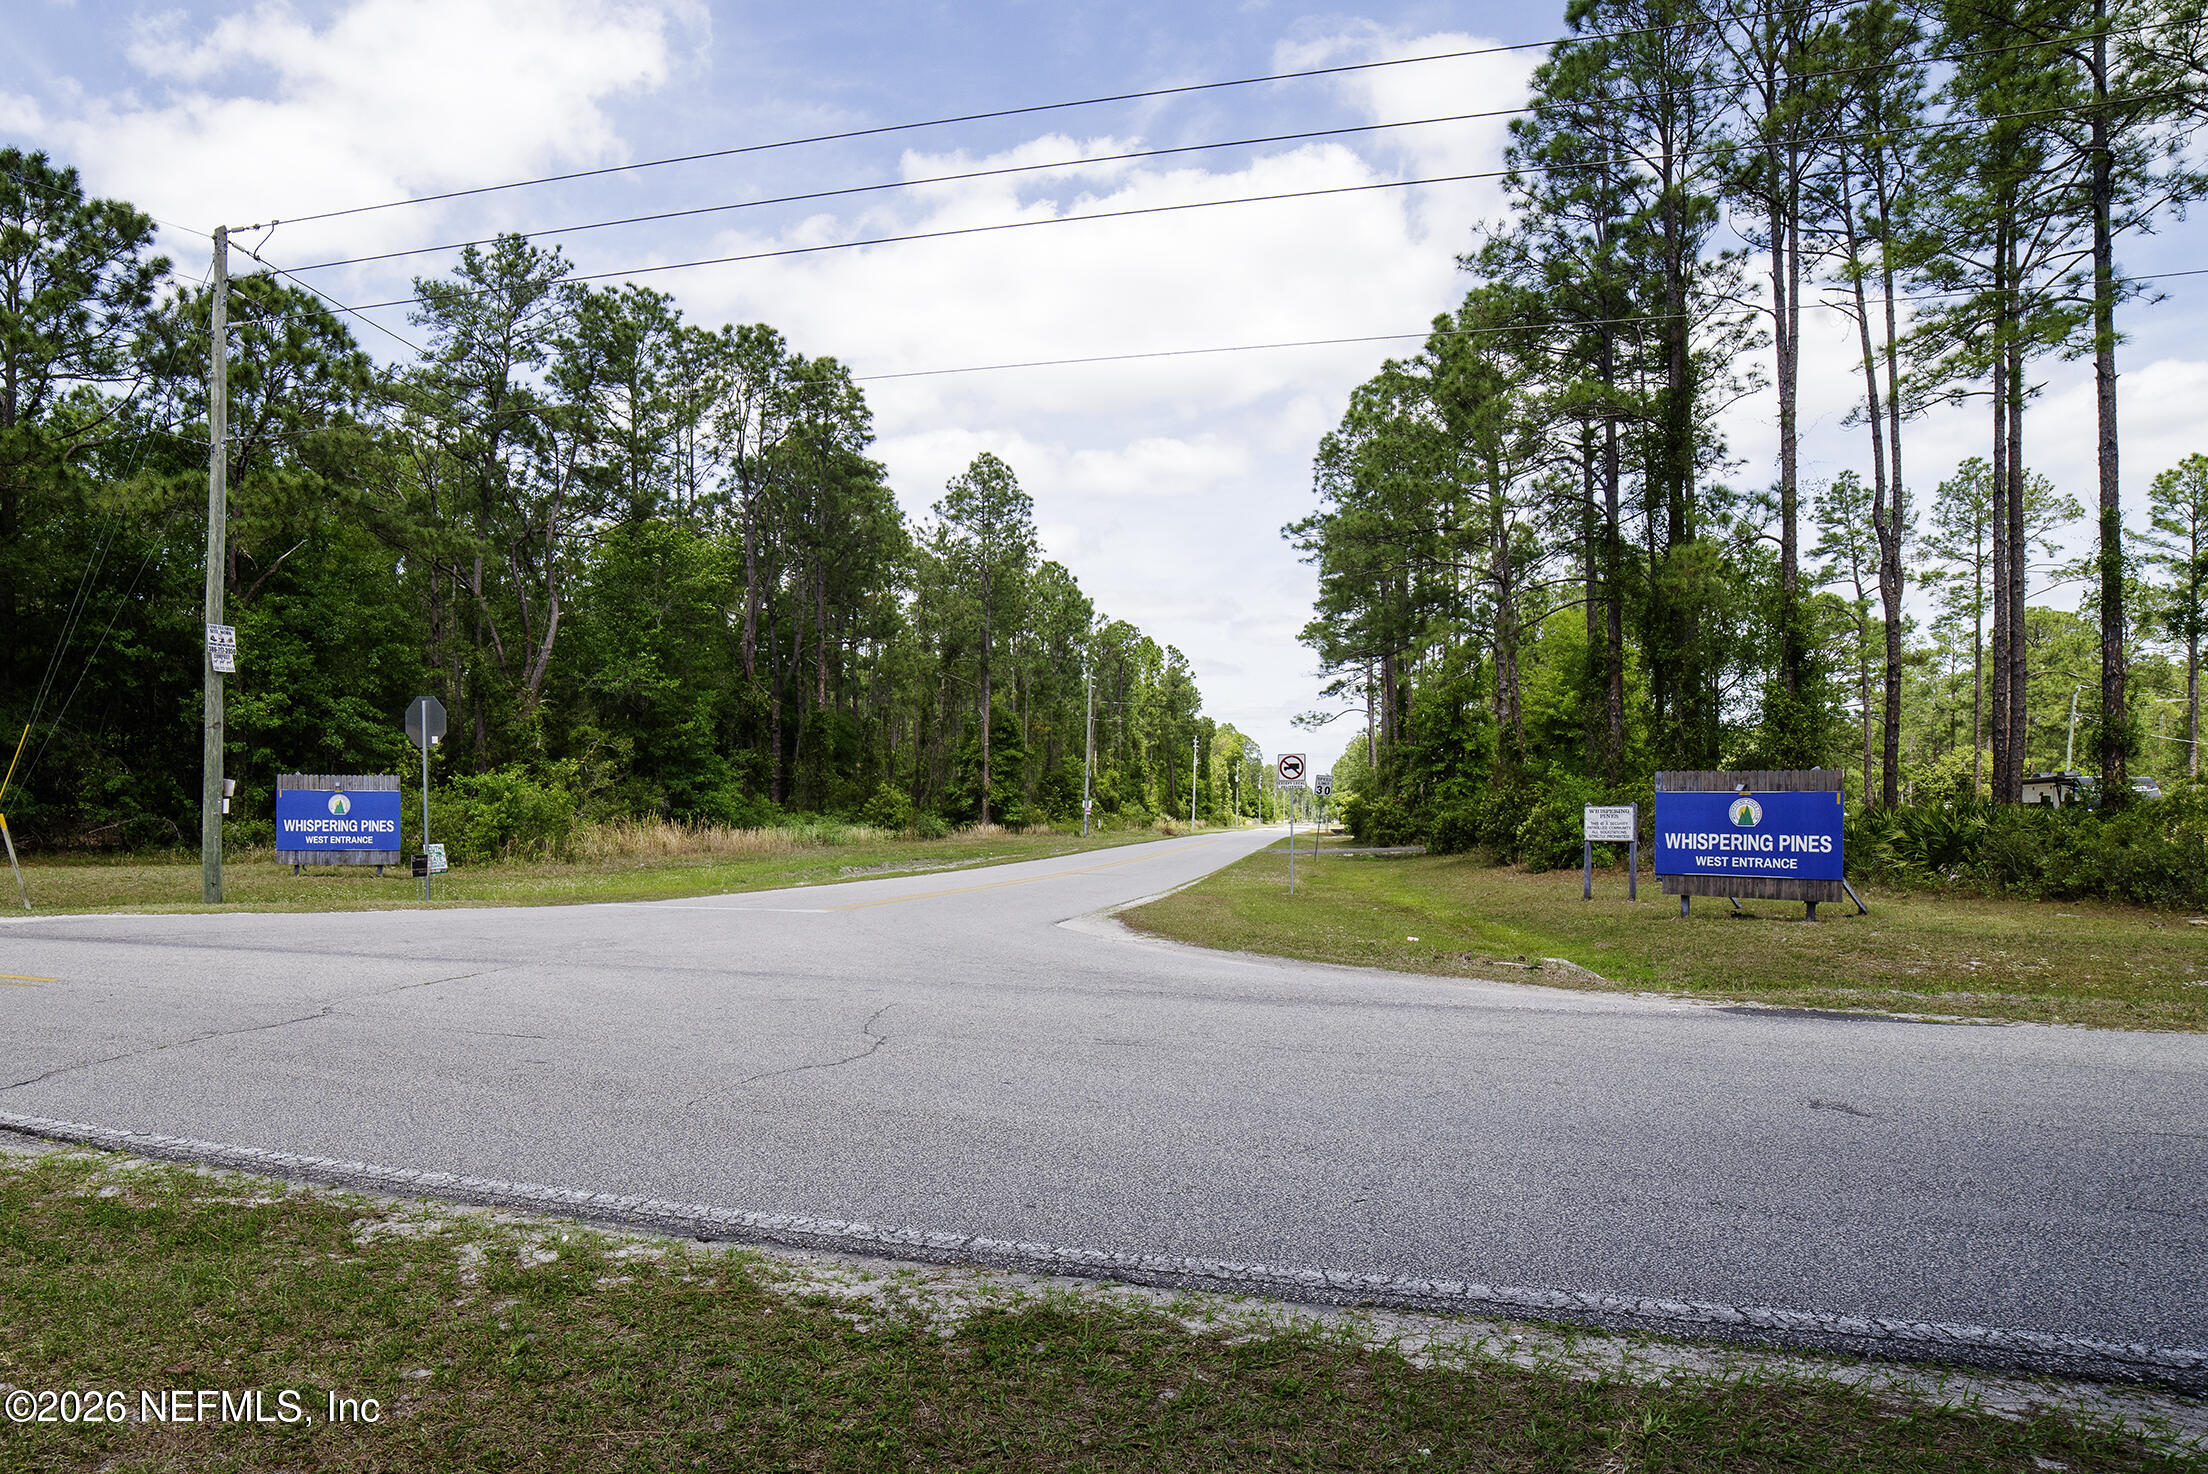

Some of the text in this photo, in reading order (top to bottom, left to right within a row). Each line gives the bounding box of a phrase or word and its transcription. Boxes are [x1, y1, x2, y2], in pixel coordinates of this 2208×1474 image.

[1316, 785, 1331, 795] 30
[284, 819, 395, 833] WHISPERING PINES
[305, 836, 373, 844] WEST ENTRANCE
[1665, 833, 1833, 854] WHISPERING PINES
[1695, 856, 1798, 869] WEST ENTRANCE
